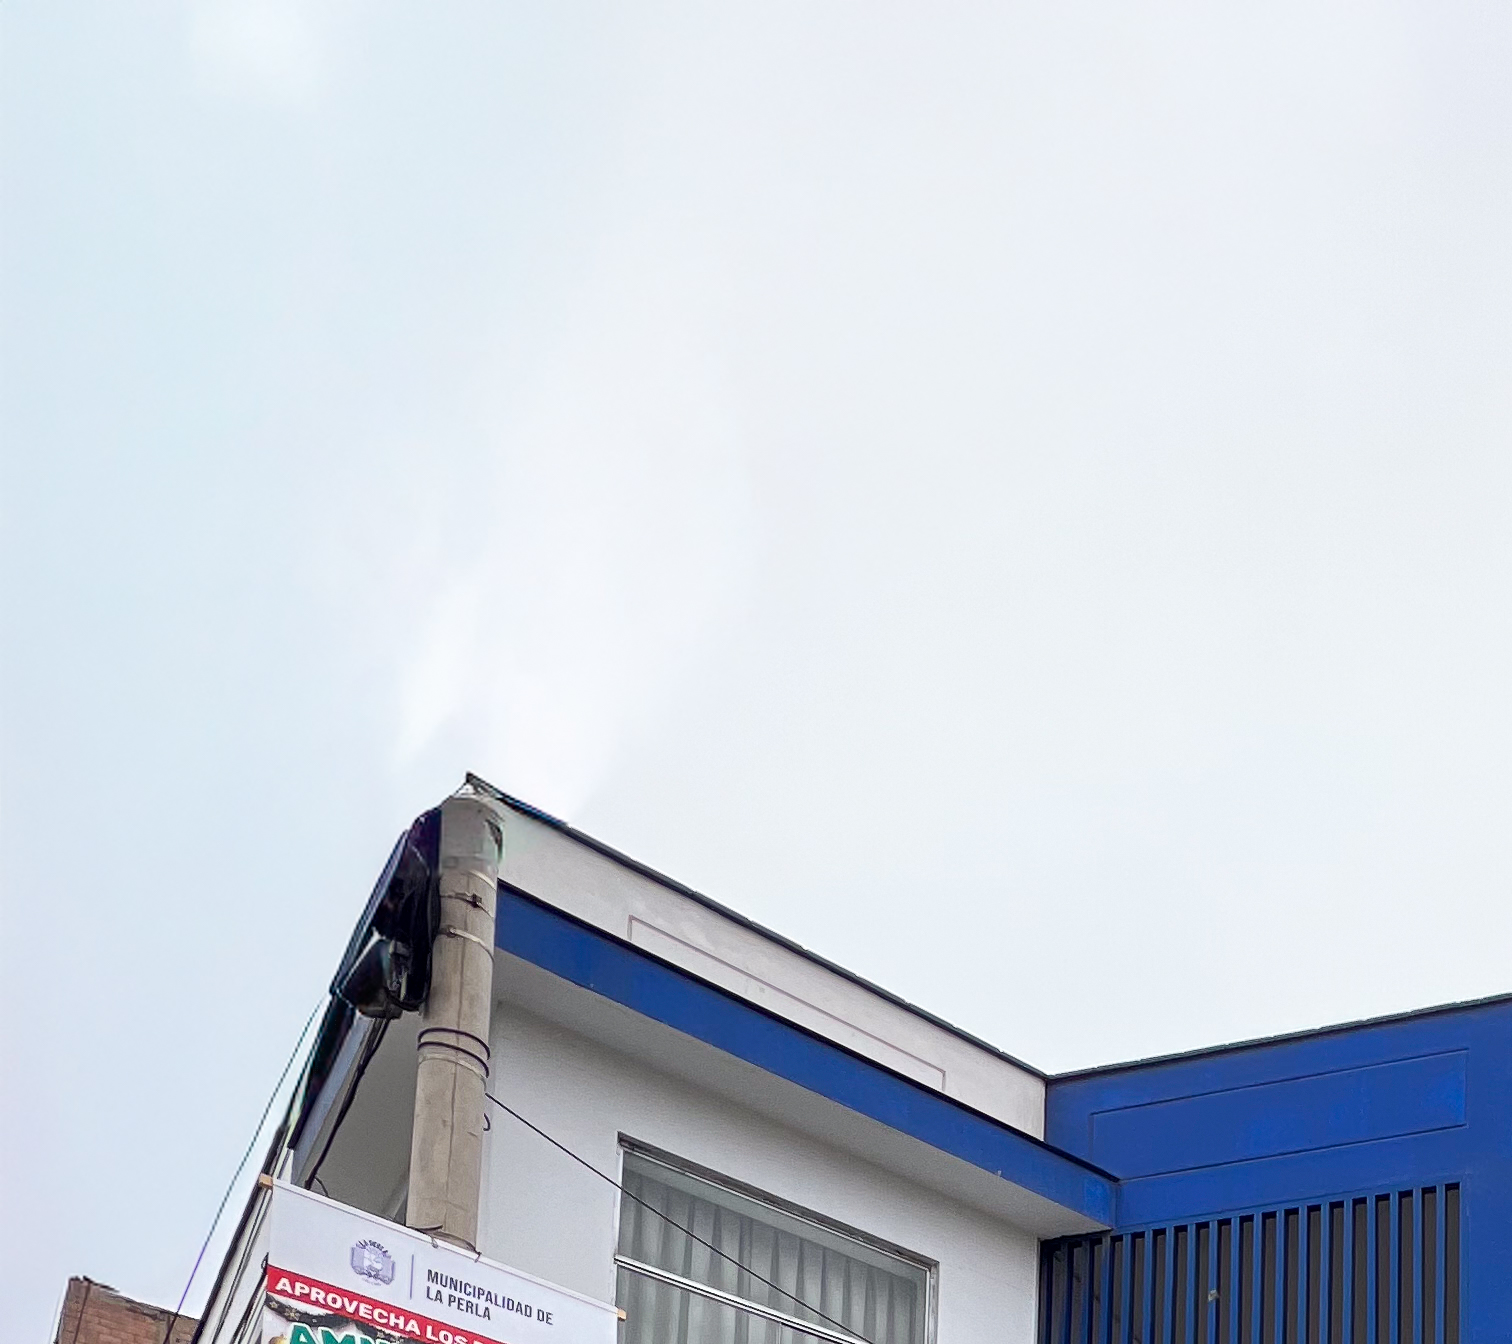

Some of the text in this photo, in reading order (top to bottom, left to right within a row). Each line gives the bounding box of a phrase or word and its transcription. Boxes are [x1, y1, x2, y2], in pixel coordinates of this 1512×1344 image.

[275, 1277, 421, 1336] APROVECHA
[426, 1285, 492, 1321] LA PERLA
[427, 1269, 554, 1326] MUNICIPALIDAD DE
